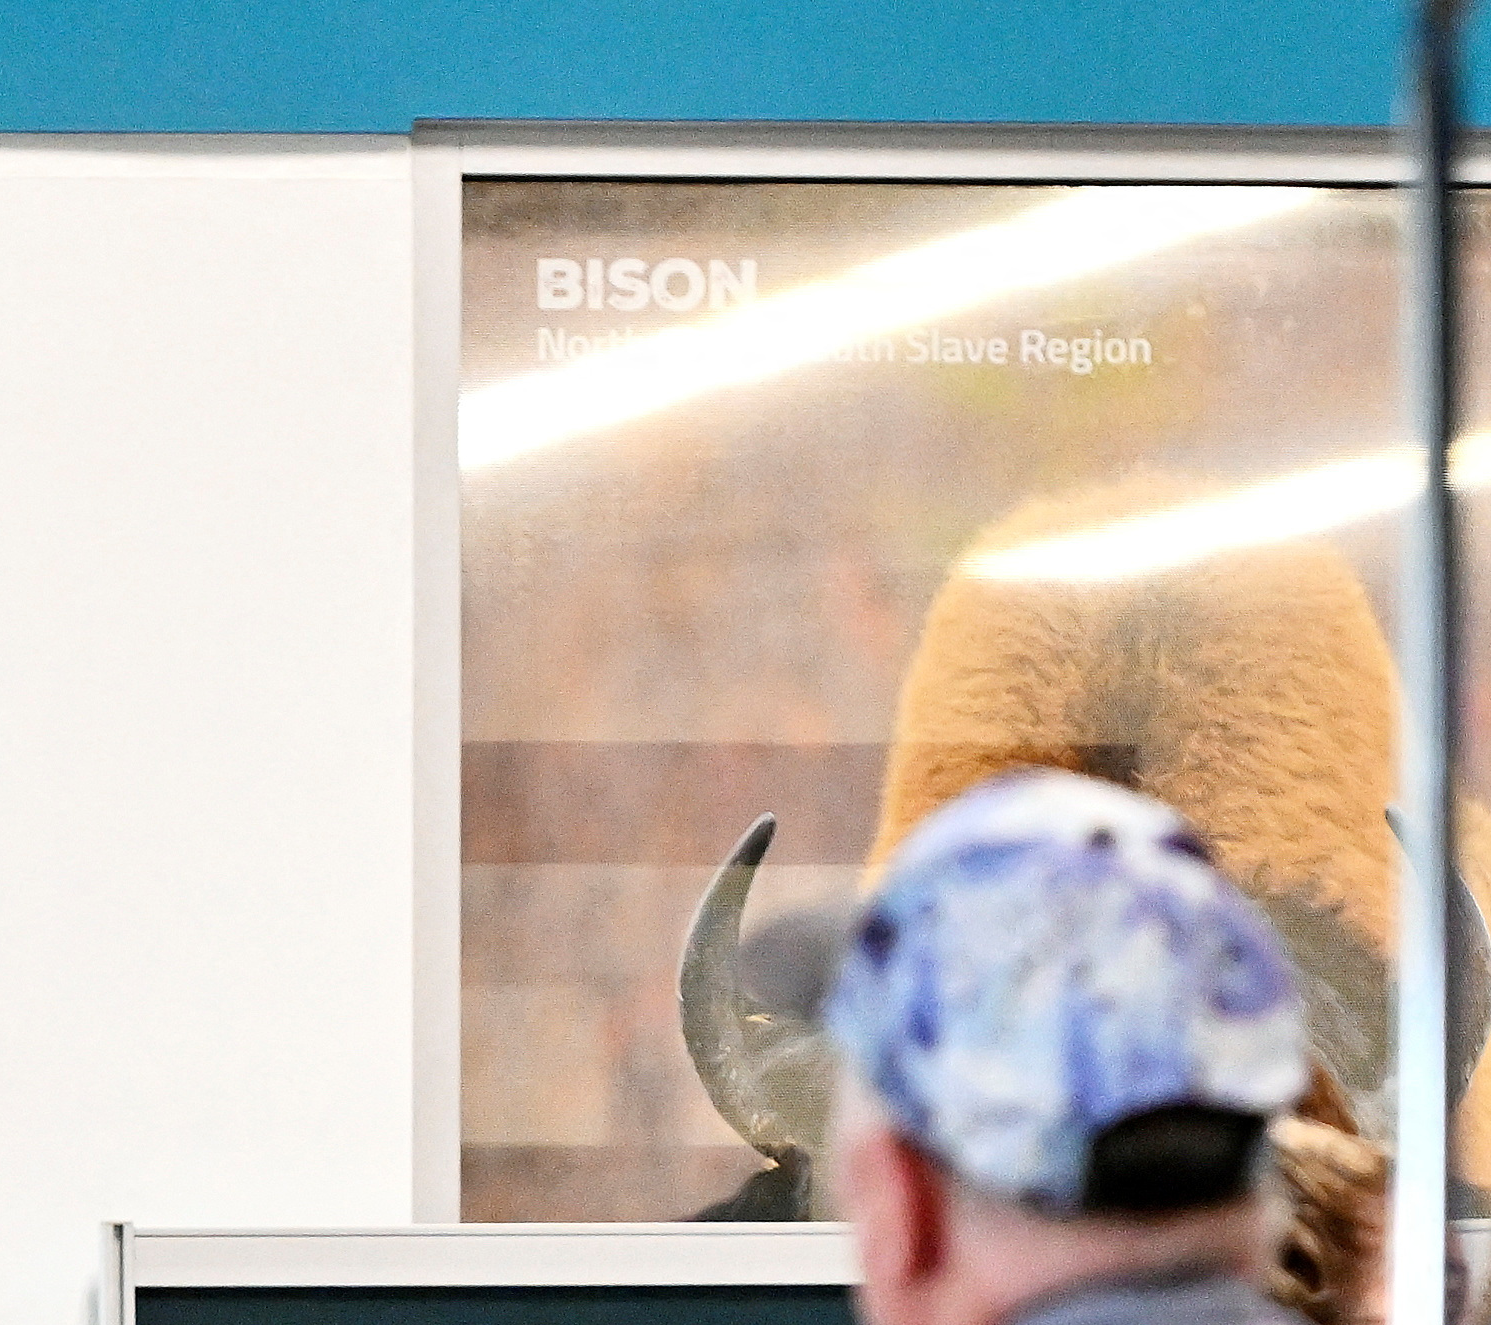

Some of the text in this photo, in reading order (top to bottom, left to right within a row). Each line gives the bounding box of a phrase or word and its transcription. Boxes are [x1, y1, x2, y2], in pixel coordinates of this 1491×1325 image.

[535, 257, 758, 310] BISON
[905, 327, 1008, 364] Slave
[1020, 327, 1153, 375] Region
